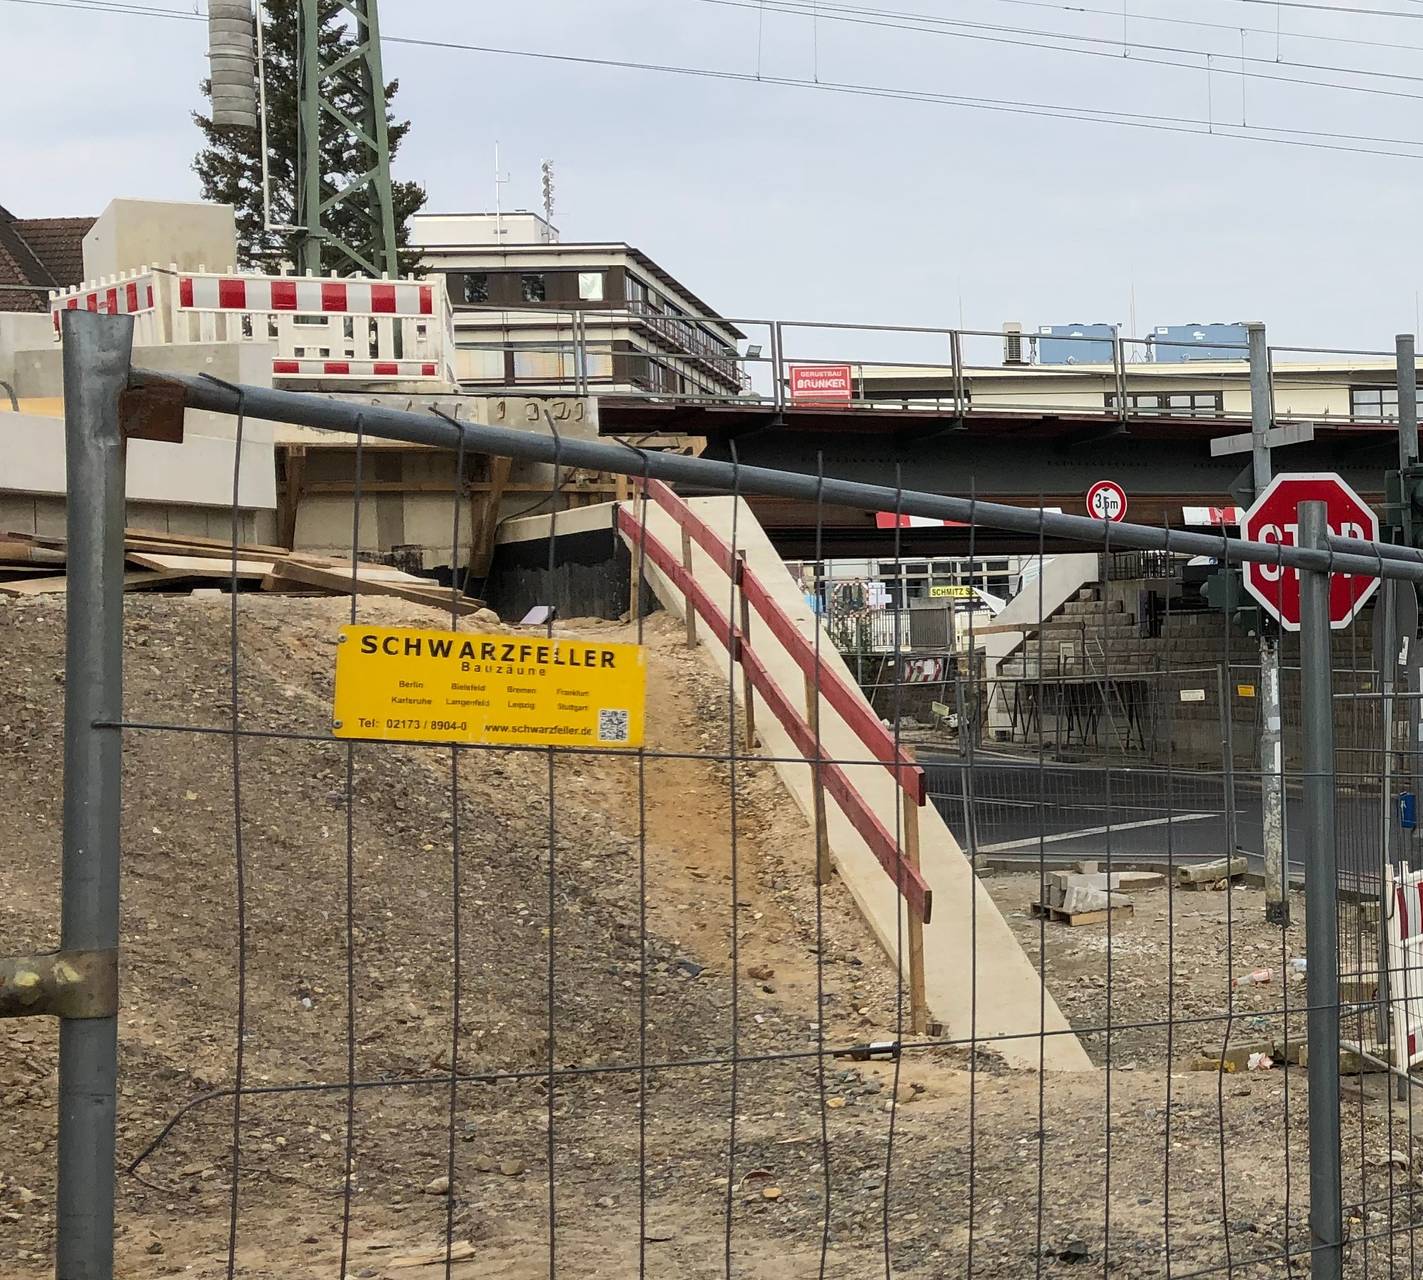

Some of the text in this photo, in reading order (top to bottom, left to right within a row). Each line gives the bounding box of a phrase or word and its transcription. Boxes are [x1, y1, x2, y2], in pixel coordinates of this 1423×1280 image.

[797, 379, 846, 388] BRÜNKER
[1258, 523, 1365, 581] STP
[931, 588, 964, 596] SCHMITZ
[361, 635, 616, 668] SCHWARZFELLER
[507, 686, 536, 694] Bremen
[556, 688, 590, 697] Frankfurt
[391, 696, 588, 712] Karlsruhe Langenfeld Leipzig Stuttgart
[358, 718, 379, 728] Tel:
[386, 719, 420, 729] 02173
[431, 720, 467, 731] 8904-0
[484, 724, 593, 736] www.schwarzfeller.de
